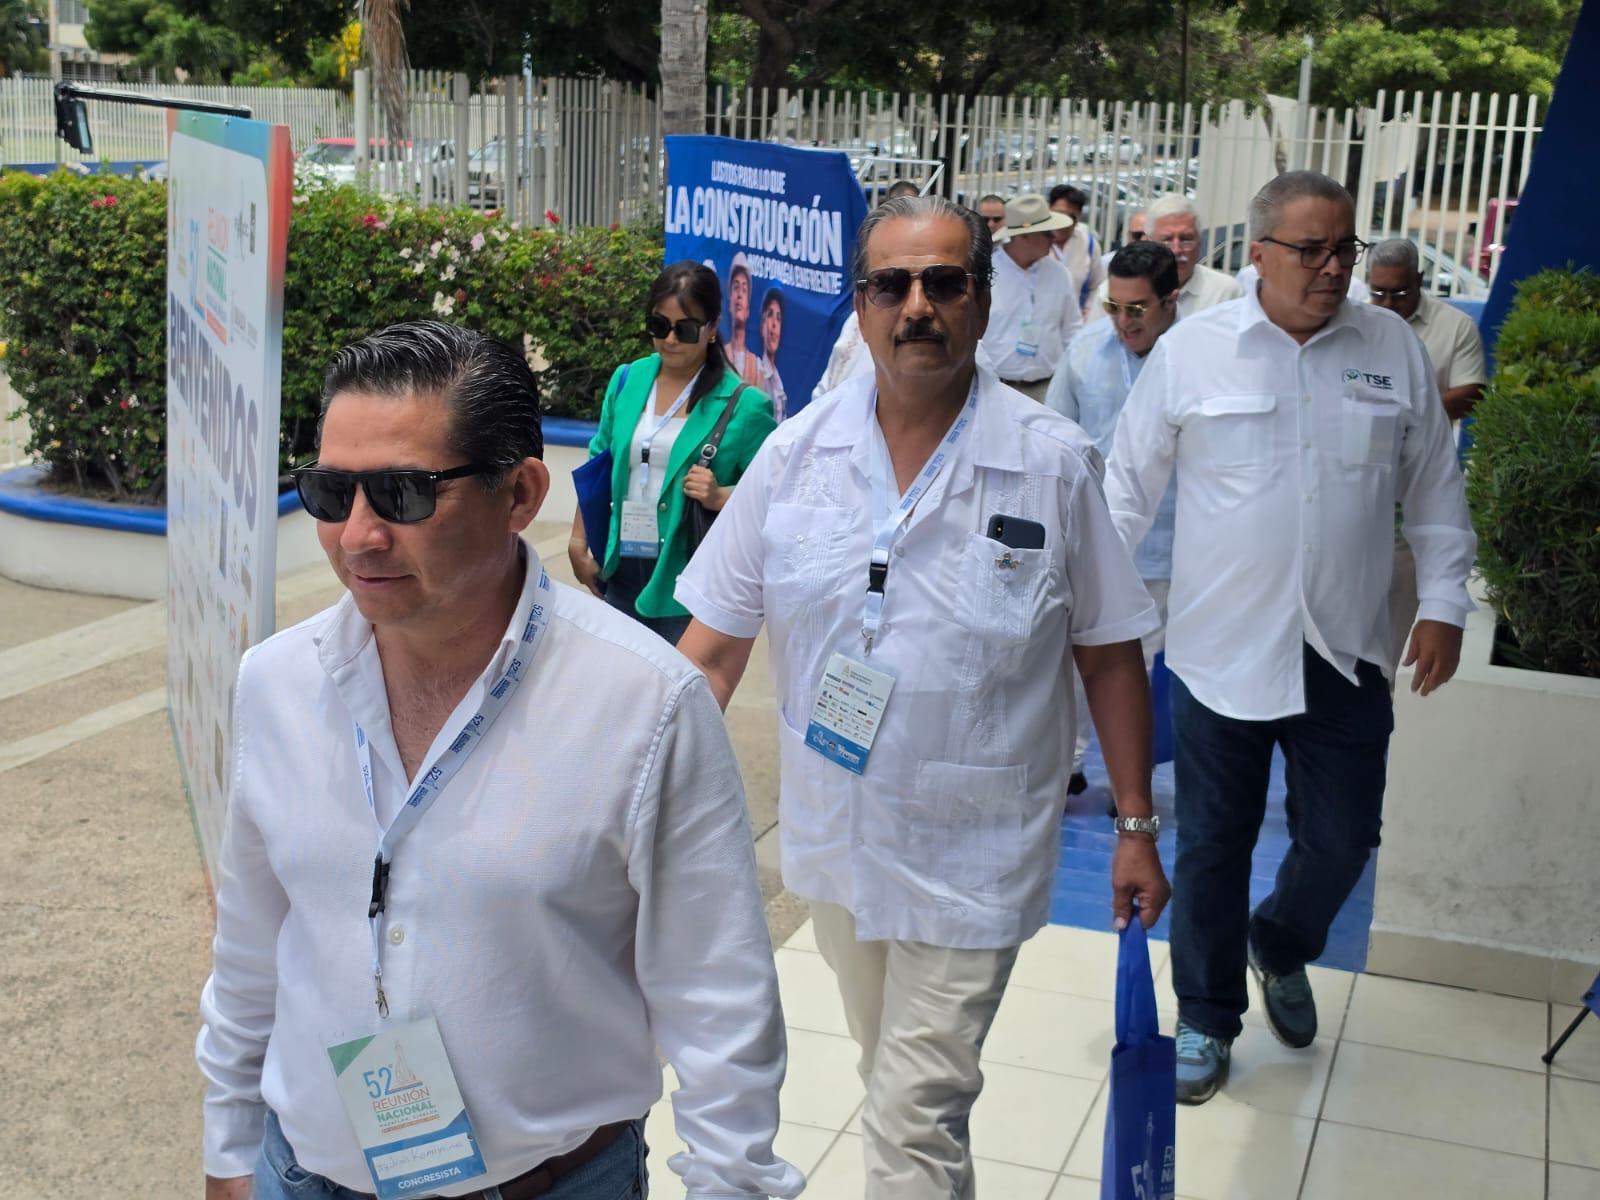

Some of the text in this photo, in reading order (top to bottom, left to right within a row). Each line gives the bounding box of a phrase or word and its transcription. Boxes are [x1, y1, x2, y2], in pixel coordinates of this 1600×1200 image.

[738, 165, 758, 189] PARA
[759, 168, 769, 191] LO
[769, 170, 786, 194] QUE
[665, 185, 844, 267] LA CONSTRUCCIÓN
[1362, 373, 1392, 386] TSE
[170, 291, 258, 532] BIENVENIDOS
[372, 1087, 430, 1112] REUNIÓN
[377, 1100, 437, 1123] NACIONAL
[398, 1167, 461, 1189] CONGRESISTA
